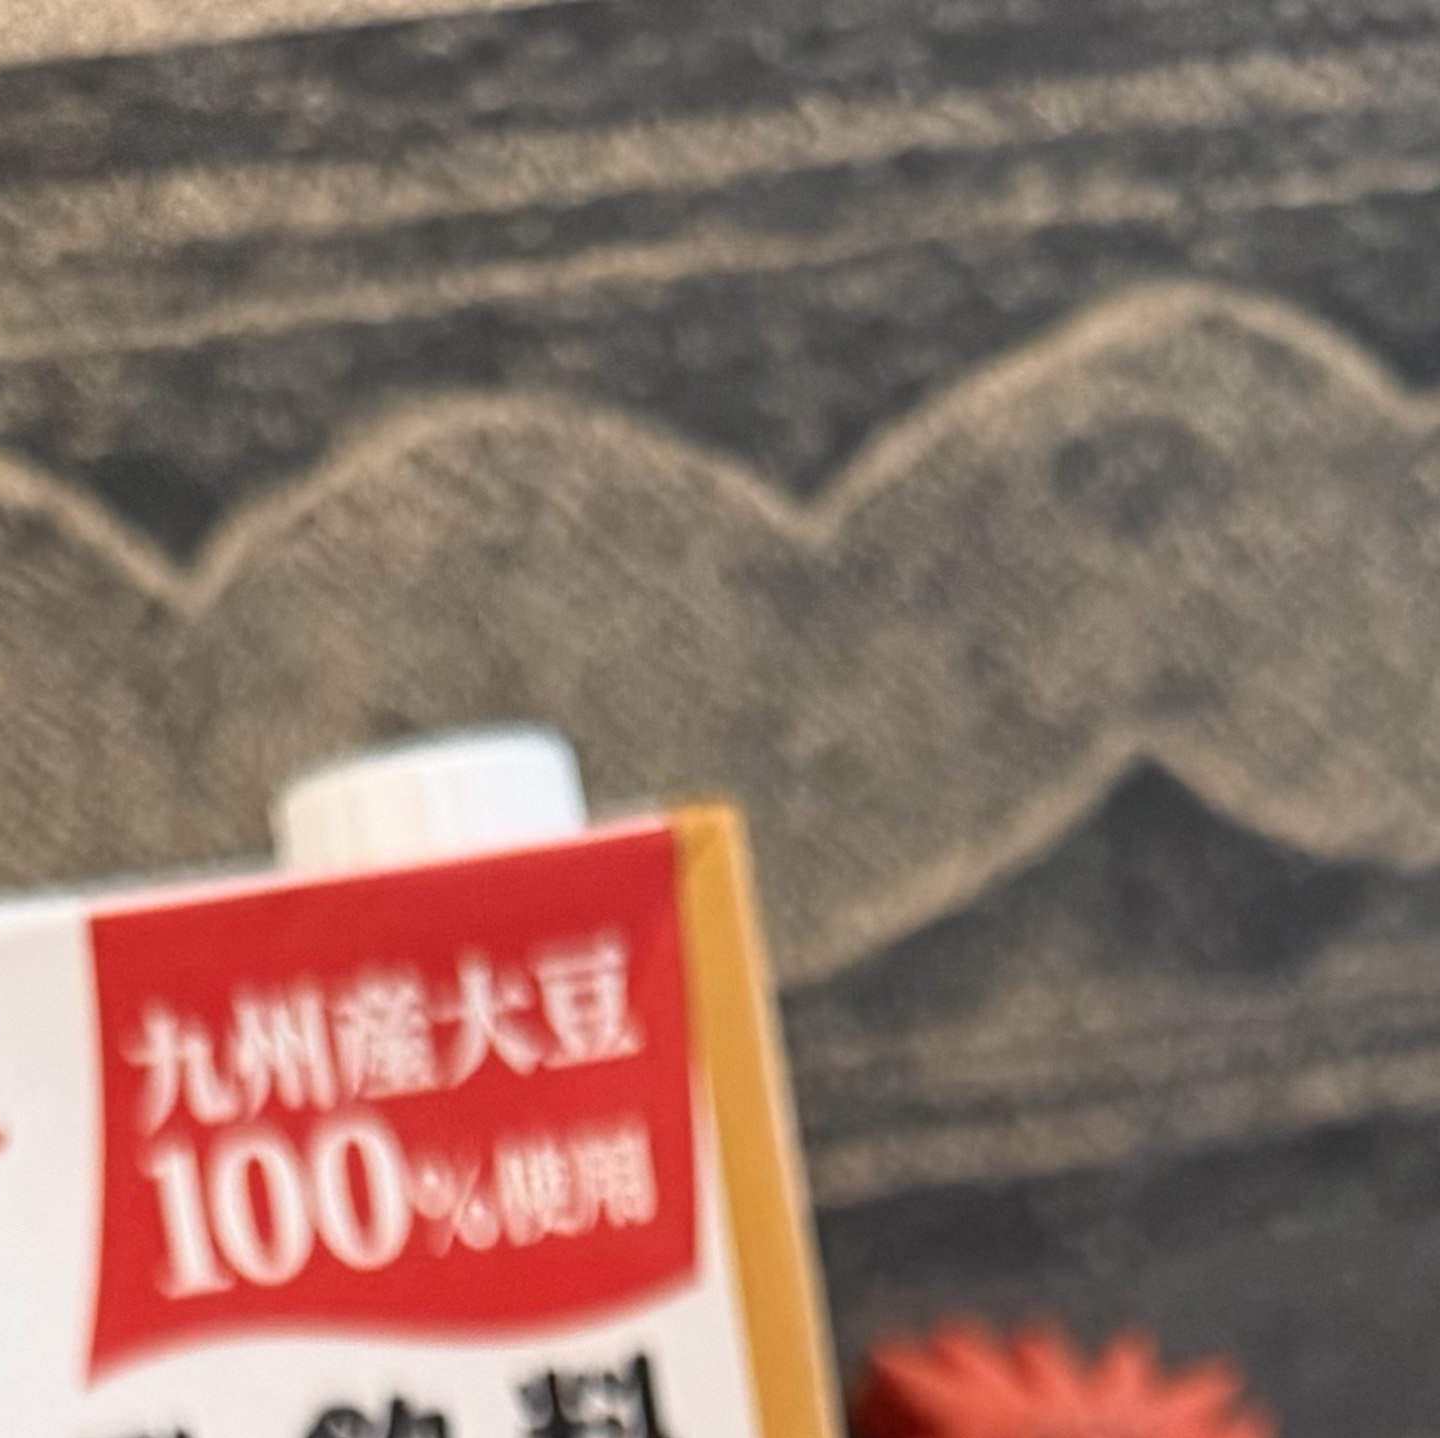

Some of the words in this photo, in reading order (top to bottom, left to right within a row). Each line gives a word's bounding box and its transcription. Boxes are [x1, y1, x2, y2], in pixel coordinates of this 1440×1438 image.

[120, 936, 642, 1132] 九州産大豆
[152, 1114, 660, 1300] 100%使用
